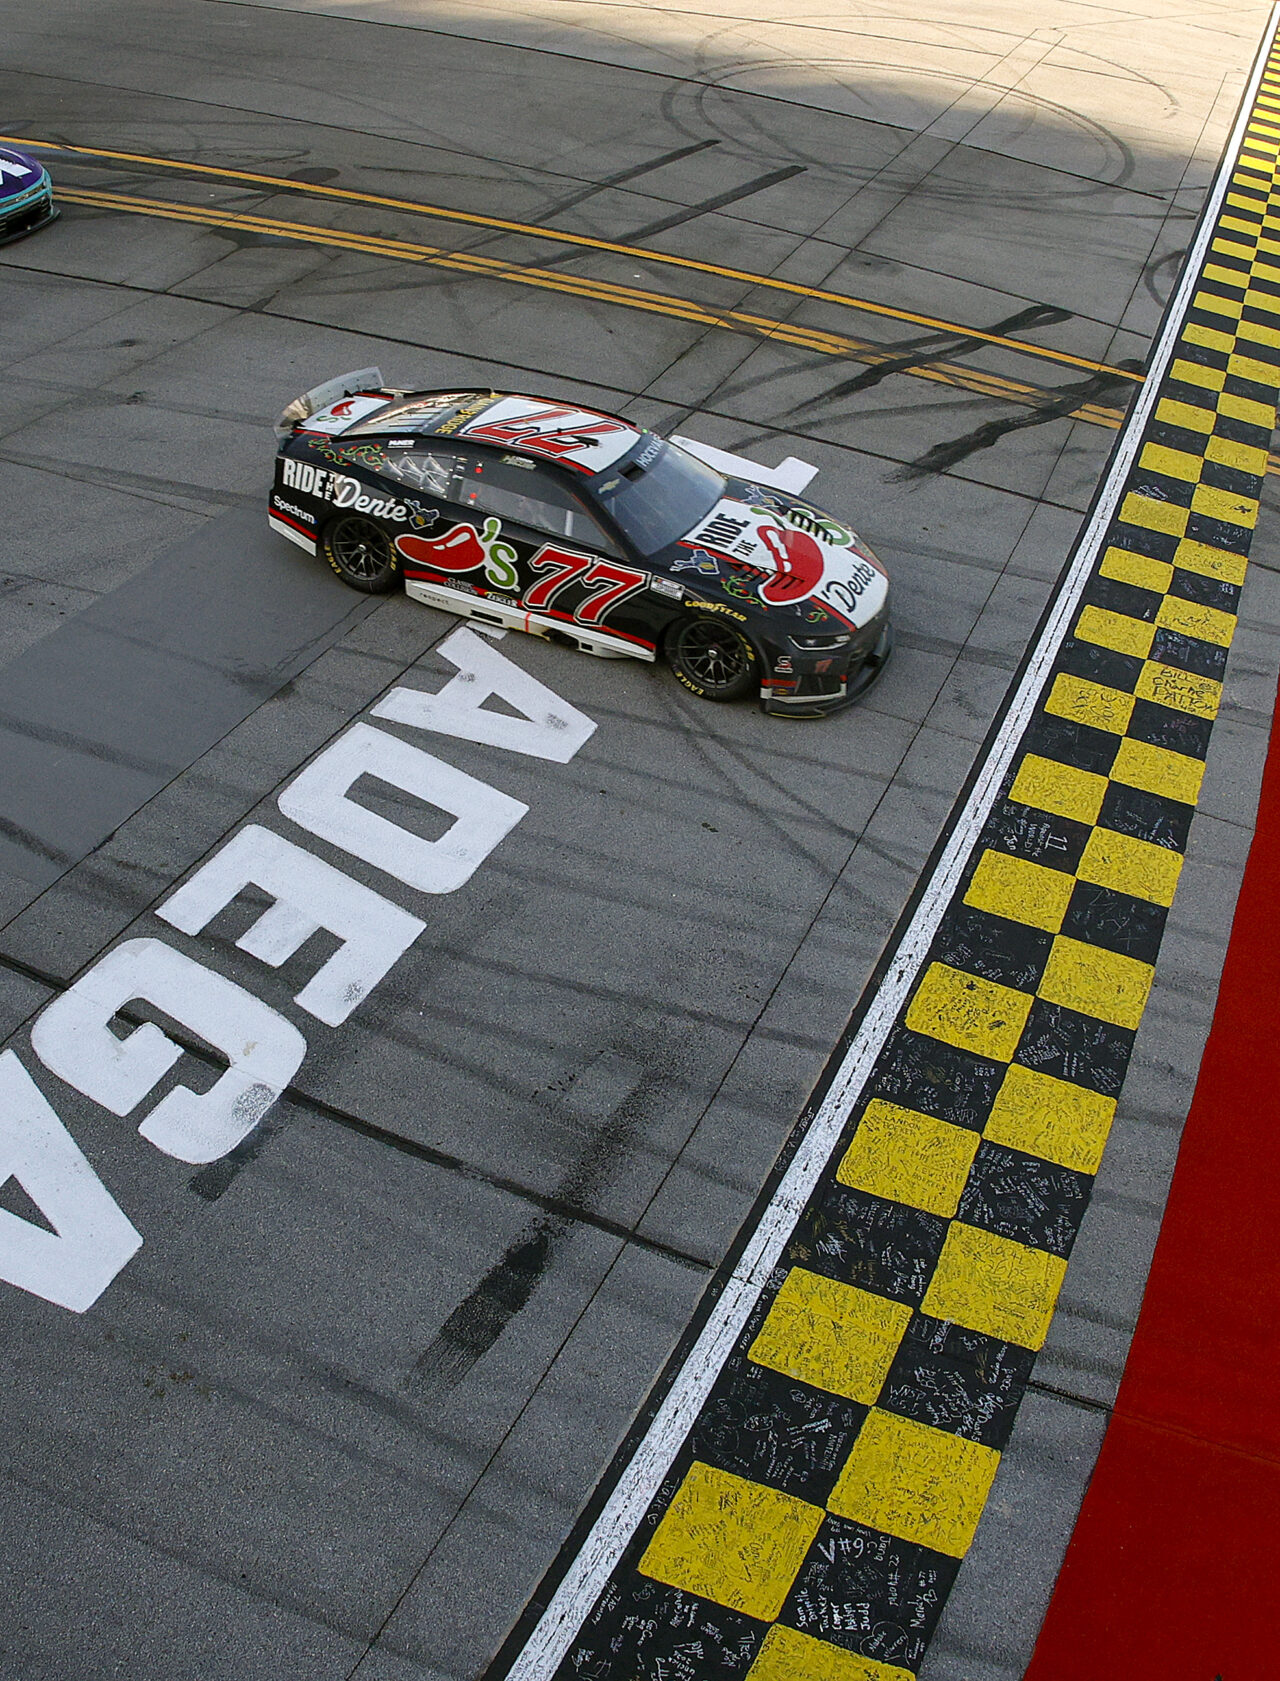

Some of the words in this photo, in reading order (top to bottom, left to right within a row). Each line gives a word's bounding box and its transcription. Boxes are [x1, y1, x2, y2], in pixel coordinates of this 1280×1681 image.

[283, 458, 327, 499] RIDE
[324, 473, 336, 501] THE
[274, 495, 315, 524] Spectrum
[697, 513, 751, 549] RIDE
[732, 539, 758, 558] THE
[521, 542, 652, 627] 77
[684, 600, 748, 622] GOODYEAR
